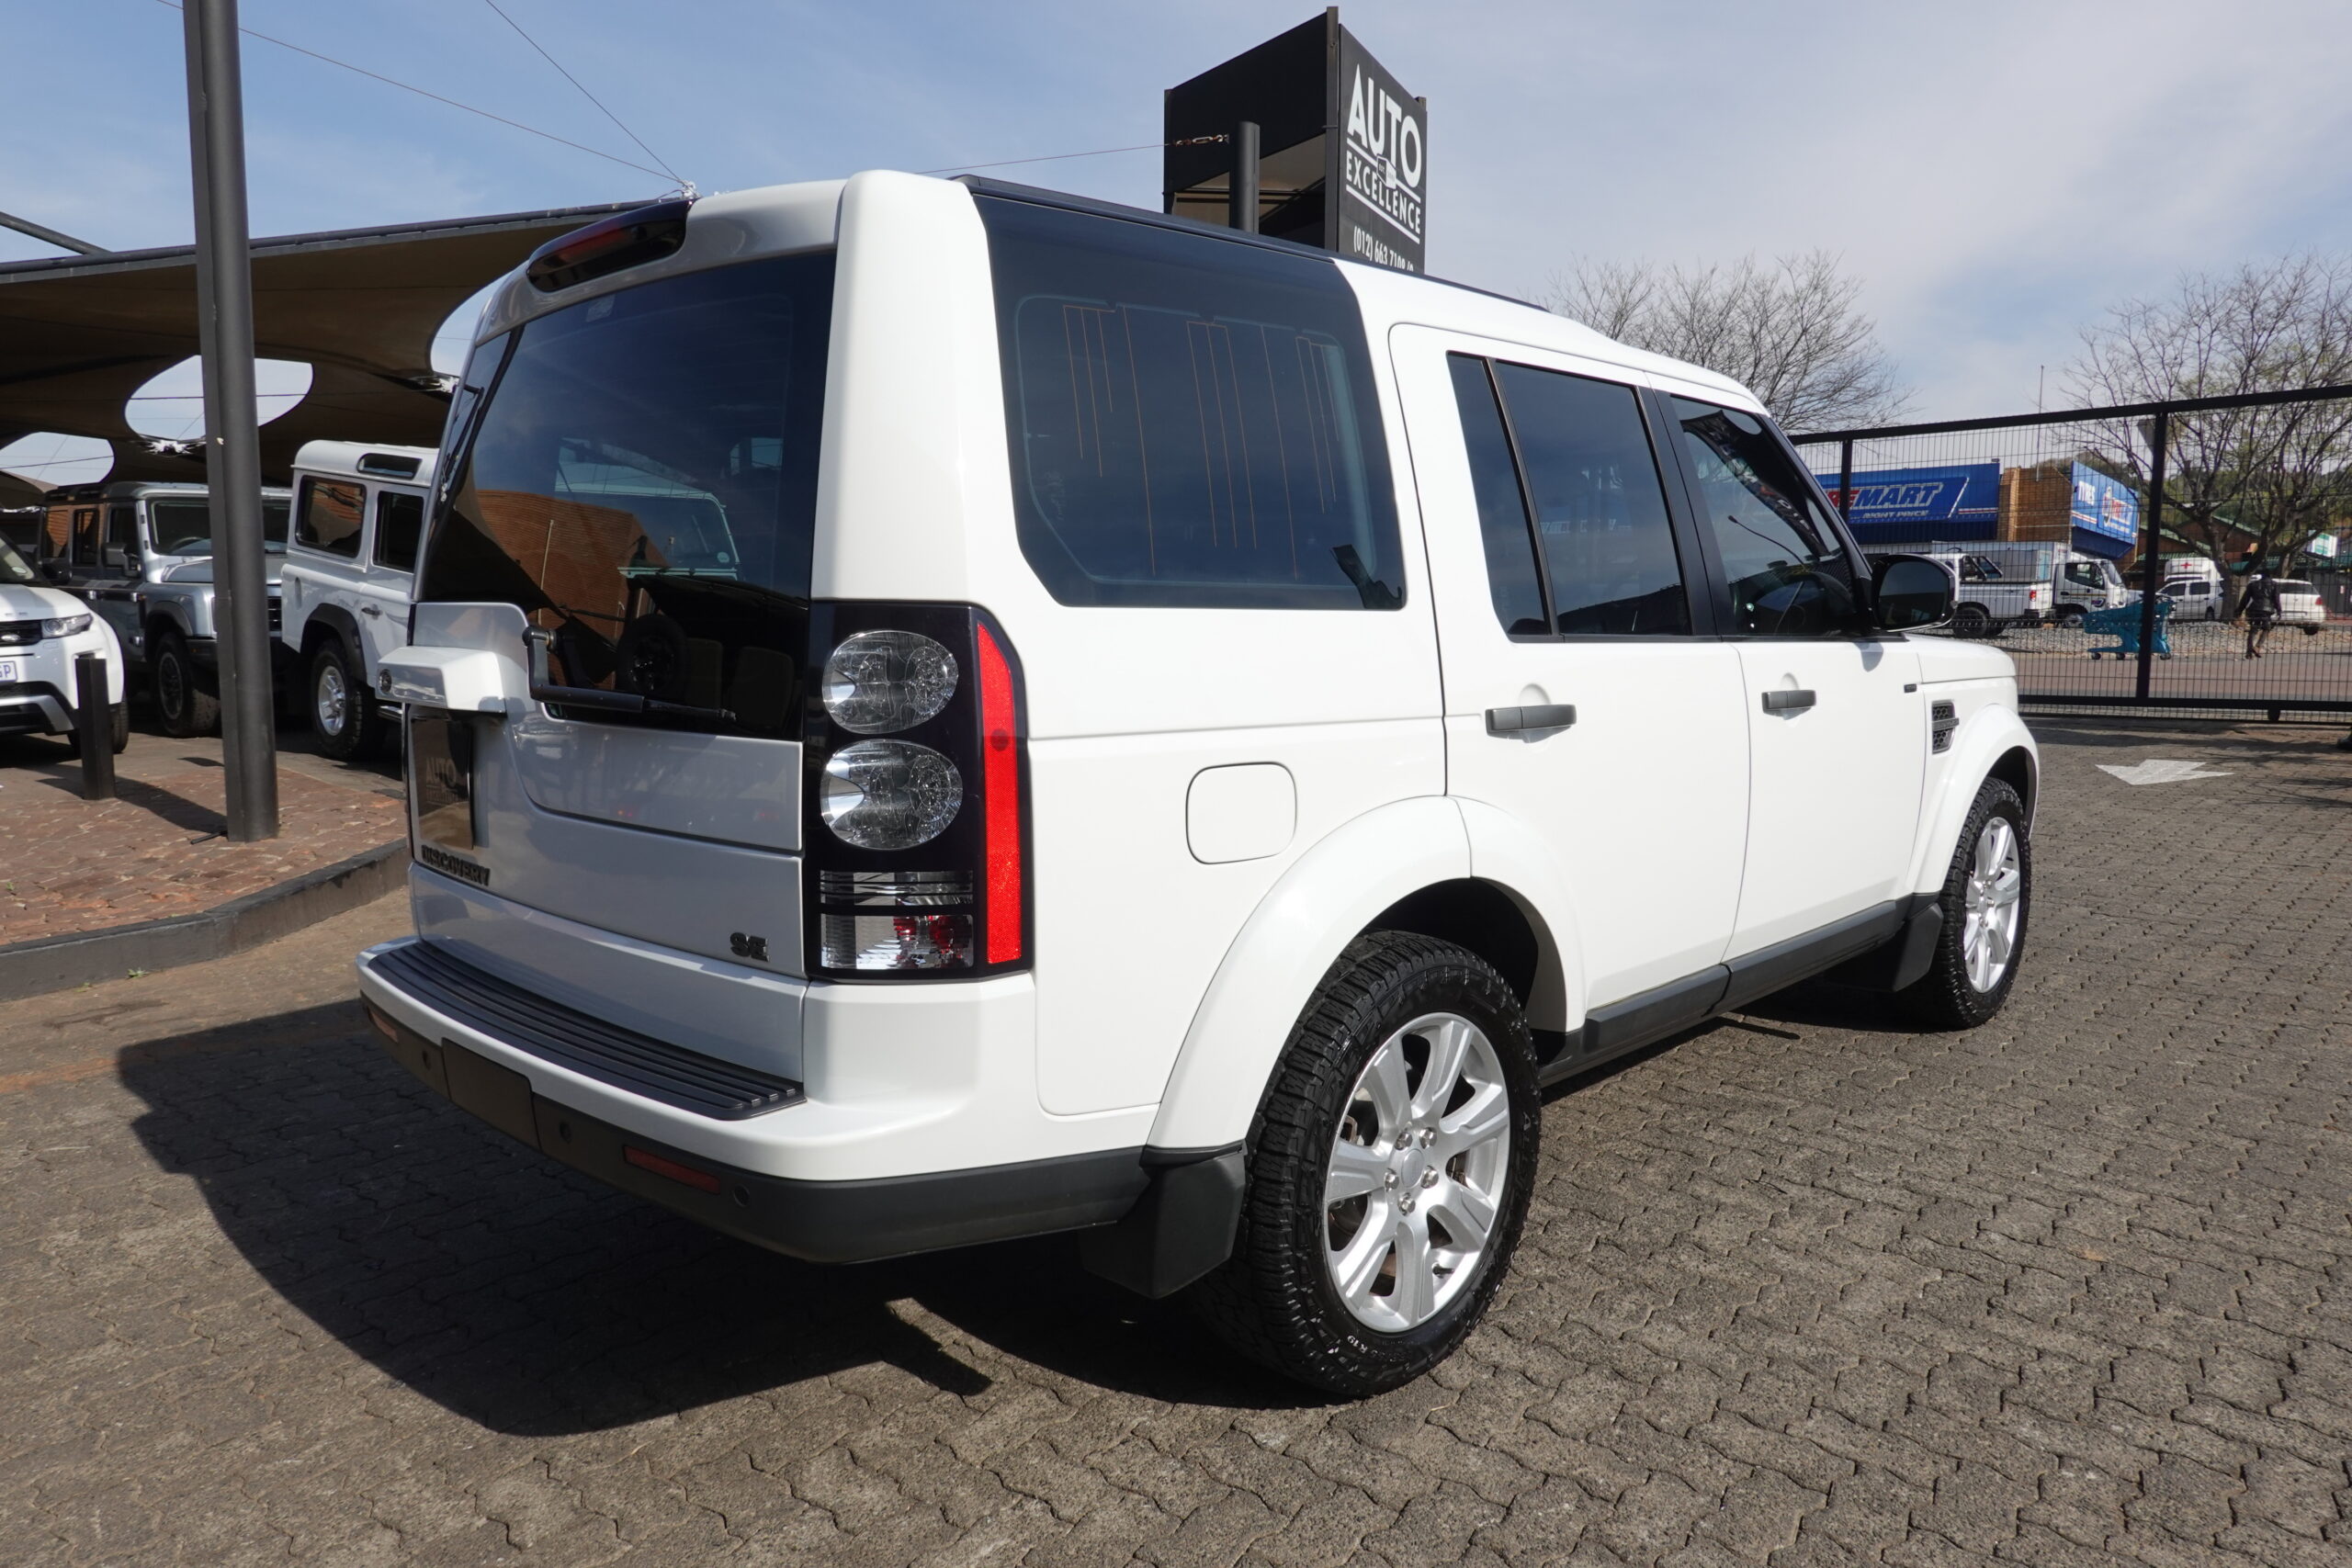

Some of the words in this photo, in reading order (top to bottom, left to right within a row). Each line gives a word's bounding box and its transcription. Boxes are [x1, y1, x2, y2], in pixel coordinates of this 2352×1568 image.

[1347, 63, 1422, 188] AUTO
[1346, 150, 1421, 235] EXCELLENCE
[1353, 225, 1374, 262] (012)
[1374, 240, 1388, 265] 663
[1825, 482, 1944, 511] REMART
[0, 664, 11, 678] P
[423, 845, 490, 886] DISCOVERY
[729, 931, 769, 962] SE
